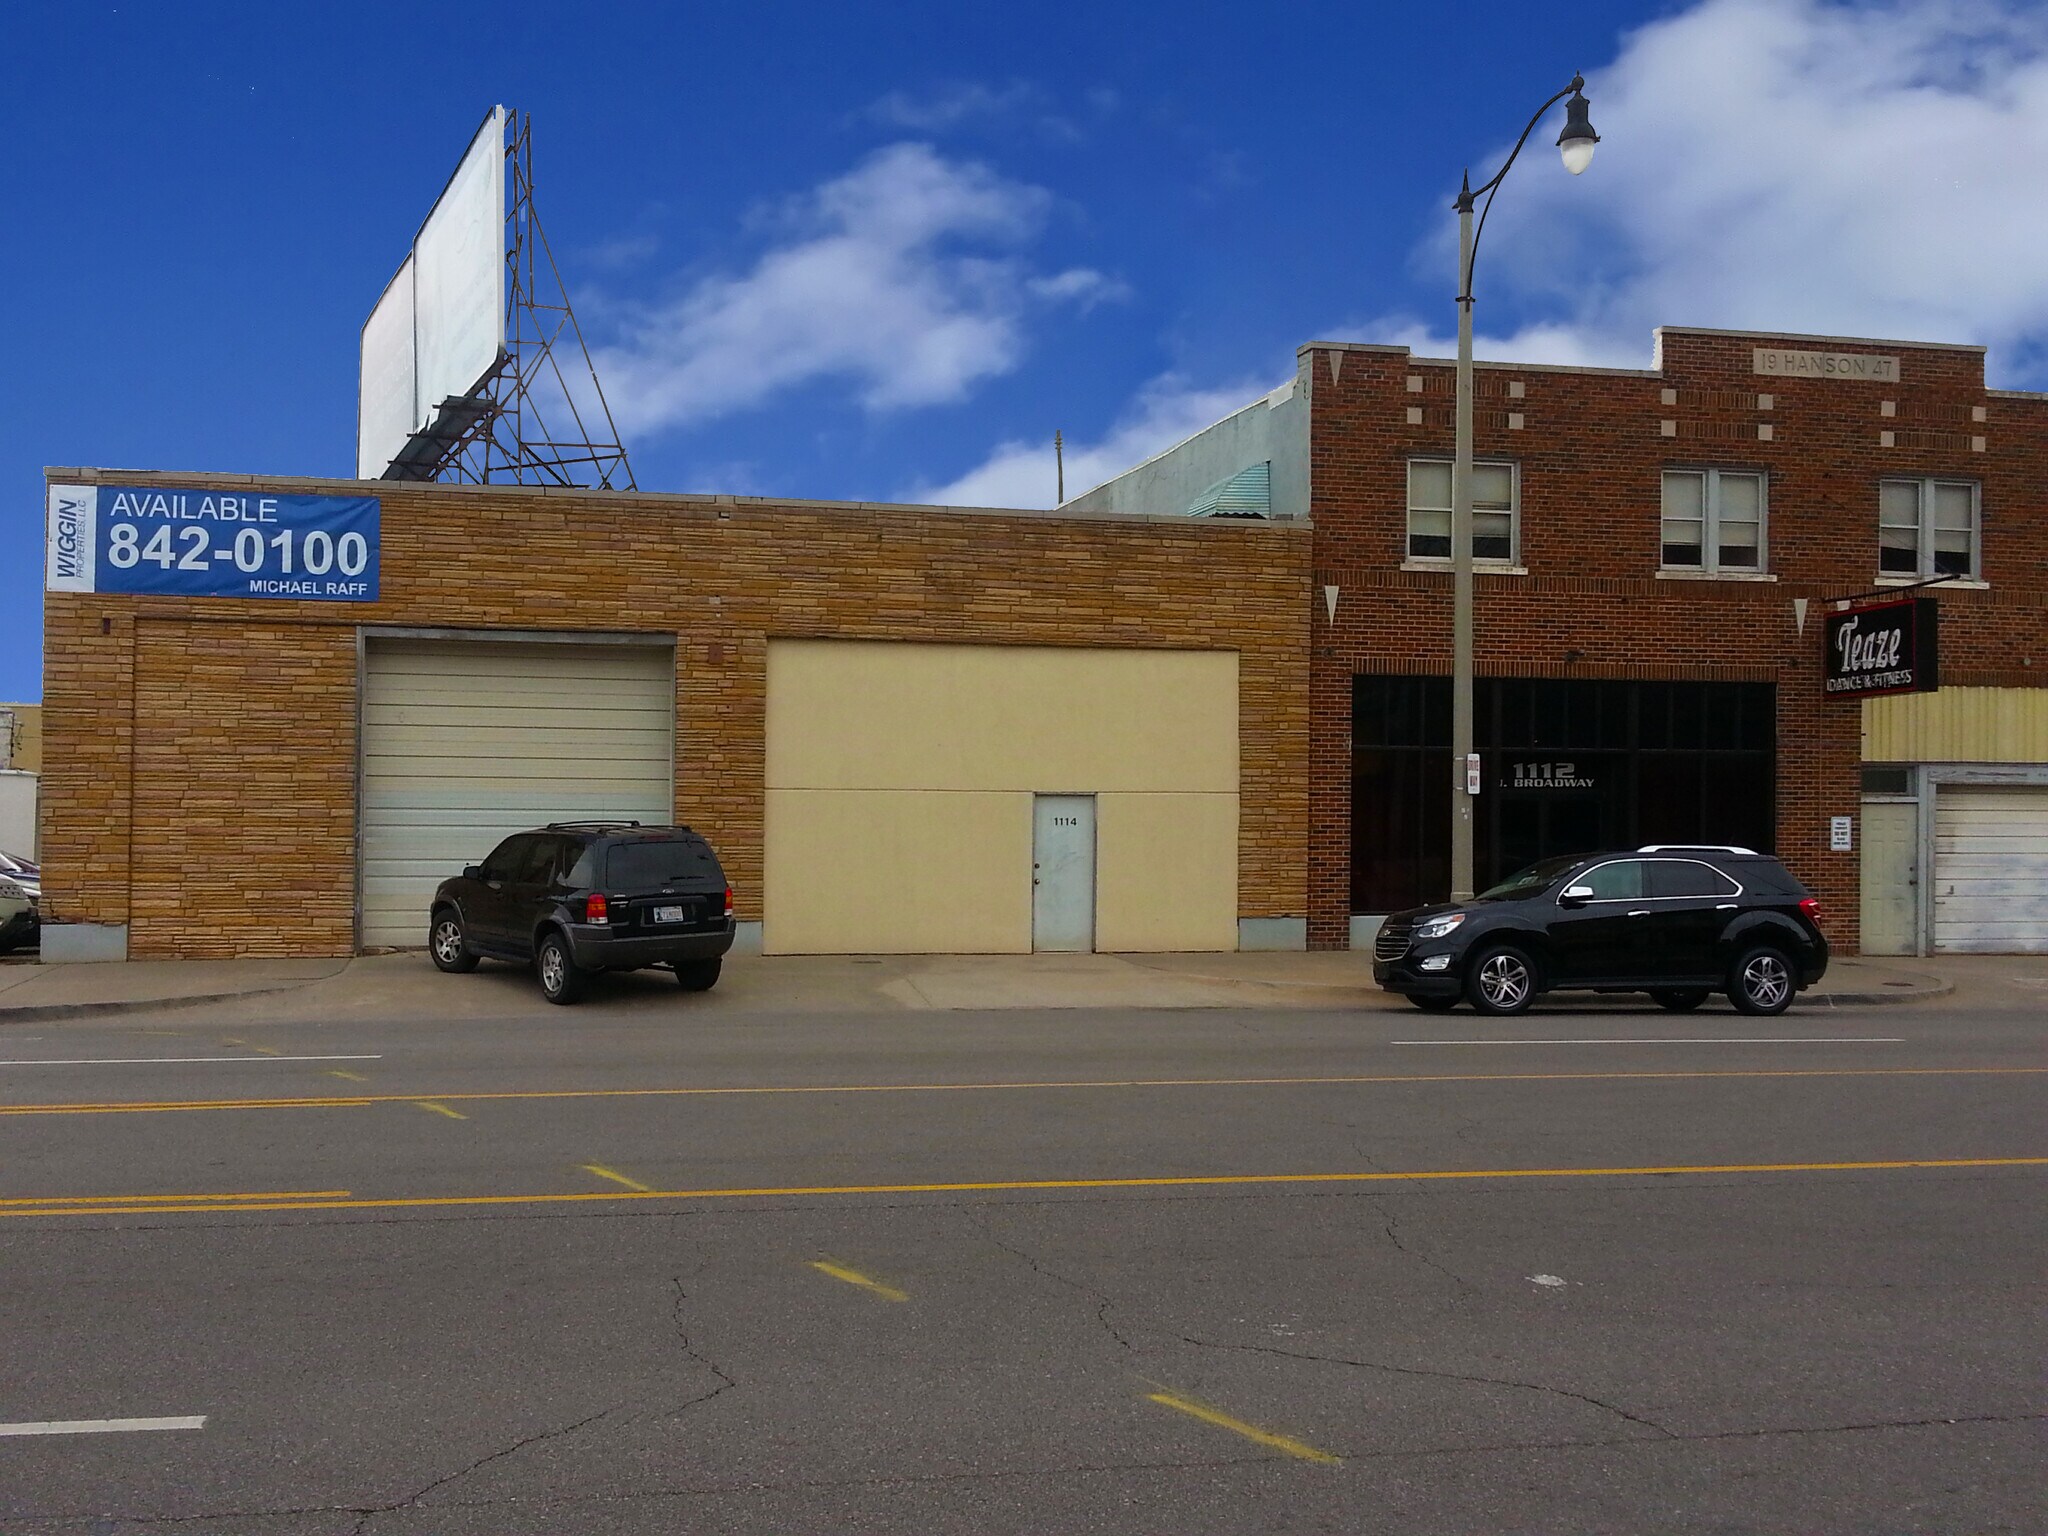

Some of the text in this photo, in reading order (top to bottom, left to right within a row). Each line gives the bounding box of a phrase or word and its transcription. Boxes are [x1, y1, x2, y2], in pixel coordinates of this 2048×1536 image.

[1762, 353, 1892, 377] 19 HANSON 47
[77, 499, 87, 522] LLC
[110, 493, 278, 522] AVAILABLE
[57, 499, 78, 578] WIGGIN
[108, 524, 368, 576] 842-0100
[250, 580, 368, 596] MICHAEL RAFF
[1836, 615, 1901, 672] Teaze
[1827, 676, 1862, 691] DANCE
[1513, 763, 1575, 778] 1112
[1514, 779, 1594, 787] BROADWAY
[1054, 817, 1077, 826] 1114
